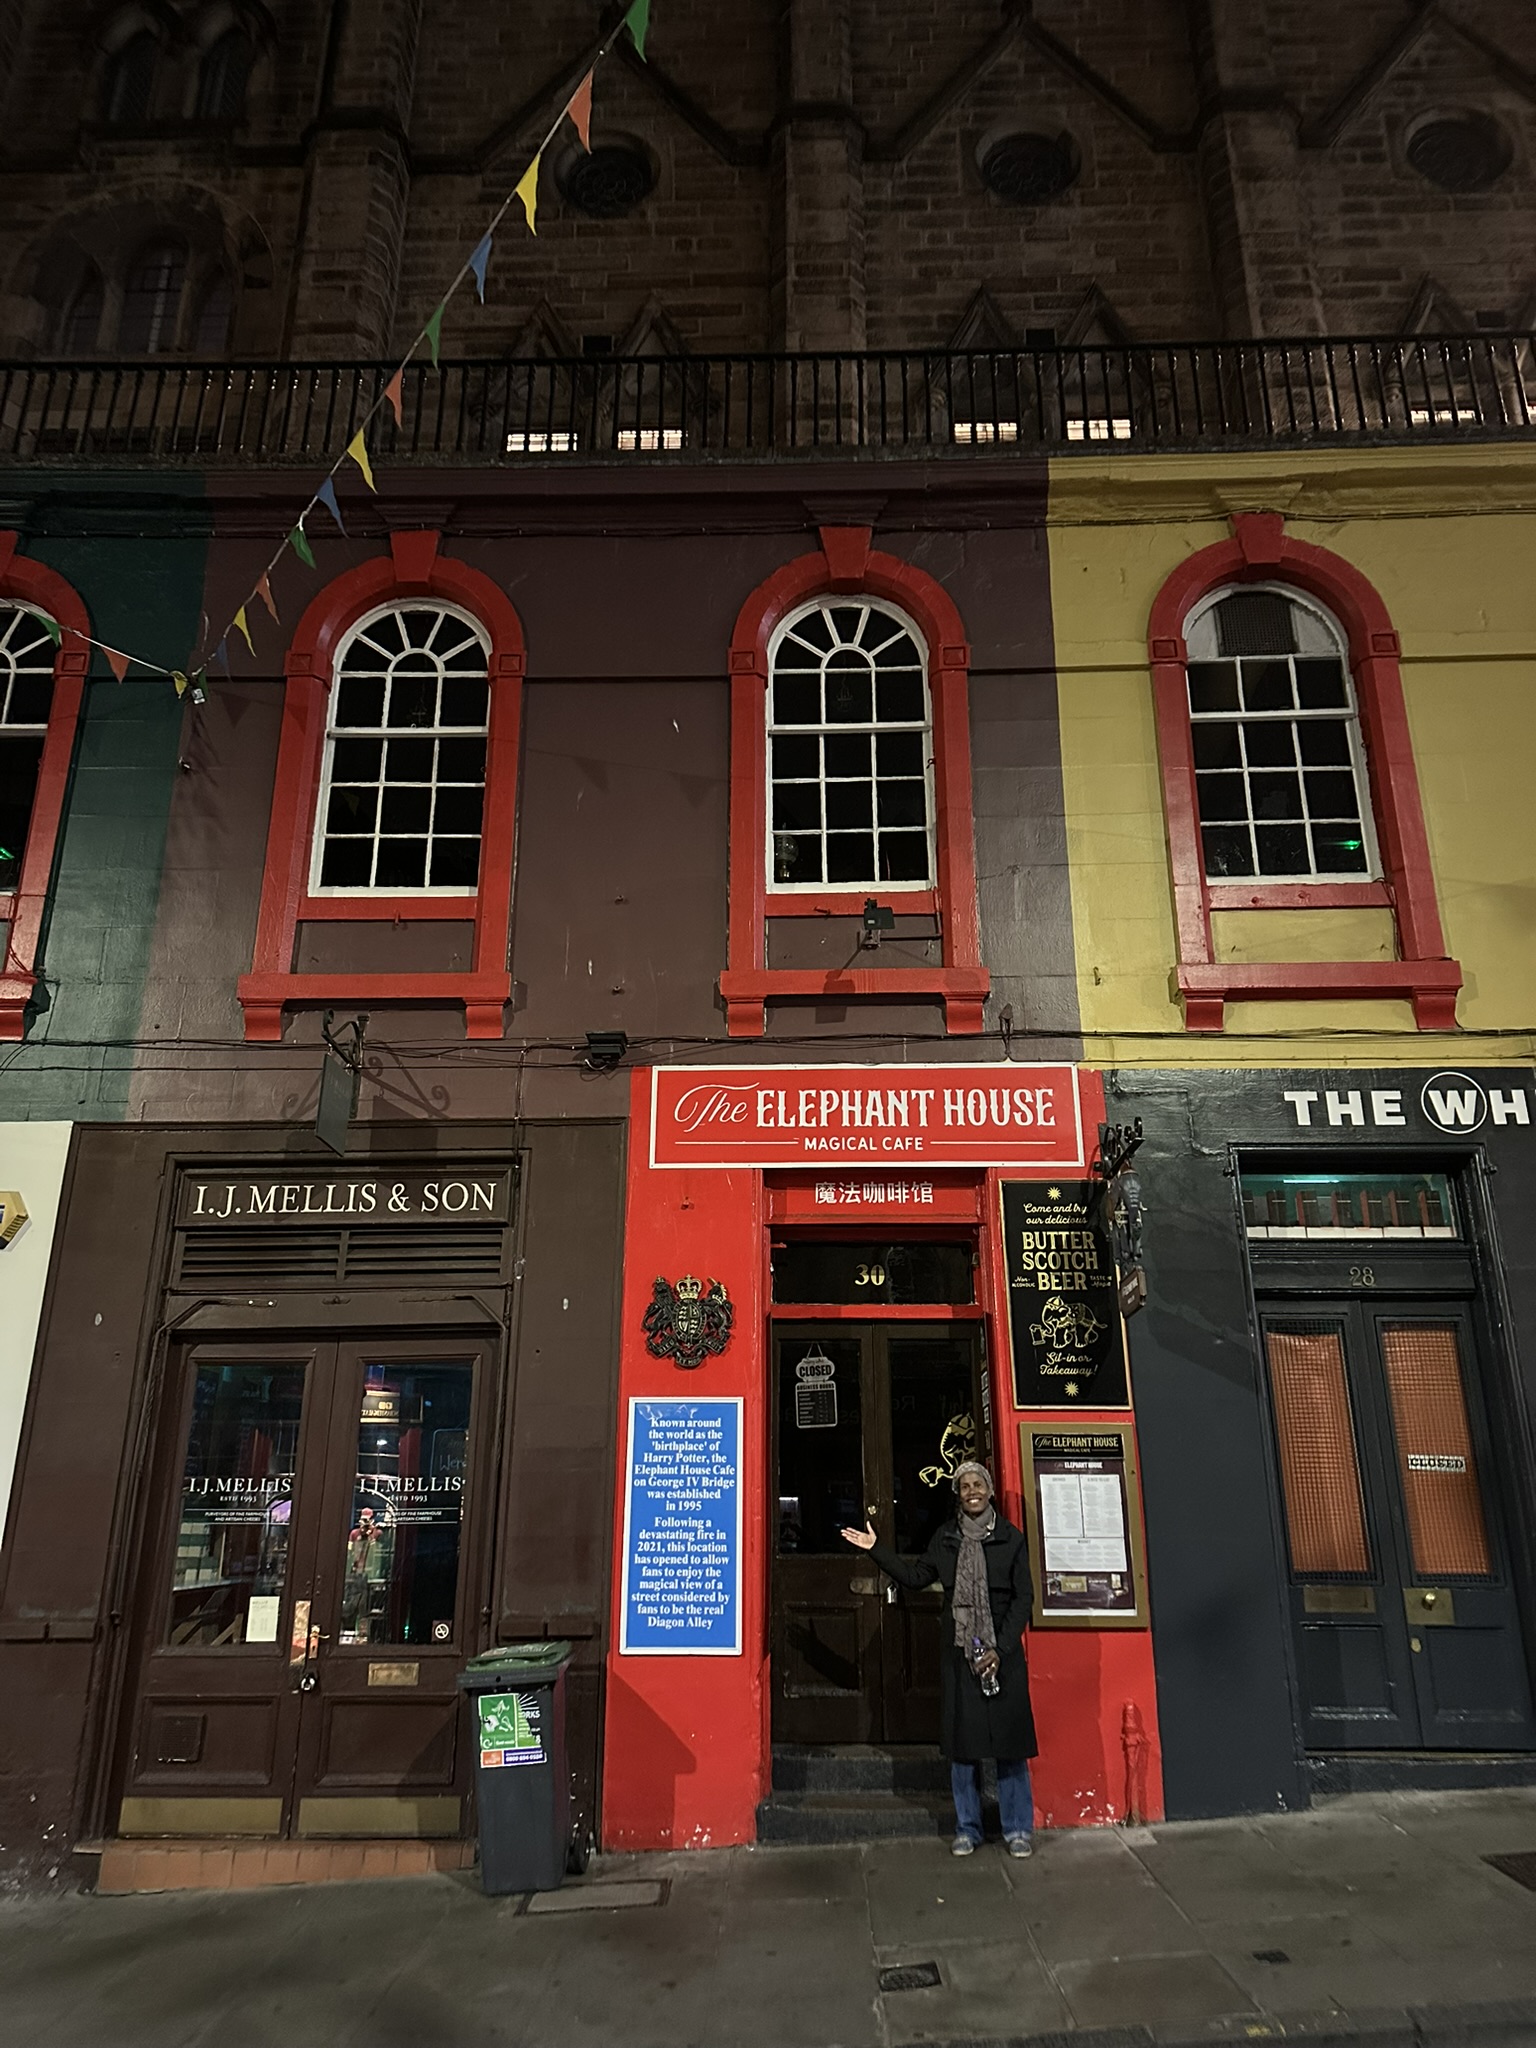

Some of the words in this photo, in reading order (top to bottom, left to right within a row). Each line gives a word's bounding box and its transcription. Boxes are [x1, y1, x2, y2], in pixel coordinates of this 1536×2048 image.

[674, 1082, 759, 1133] The
[756, 1090, 934, 1127] ELEPHANT
[943, 1089, 1056, 1127] HOUSE
[1283, 1090, 1406, 1126] THE
[1428, 1090, 1536, 1126] WH
[804, 1137, 877, 1151] MAGICAL
[881, 1137, 924, 1150] CAFE
[388, 1183, 410, 1212] &
[421, 1183, 497, 1212] SON
[814, 1182, 934, 1205] 魔法咖啡馆
[1023, 1203, 1051, 1213] Come
[1053, 1203, 1072, 1212] and
[1073, 1203, 1087, 1215] try
[1045, 1214, 1088, 1224] delicious
[1022, 1231, 1095, 1250] BUTTER
[1023, 1251, 1099, 1270] SCOTCH
[854, 1264, 885, 1285] 30
[1350, 1266, 1374, 1286] 28
[1037, 1272, 1088, 1290] BEER
[1046, 1351, 1077, 1363] Sit-in
[800, 1365, 831, 1377] CLOSED
[1040, 1365, 1098, 1377] Takeaway!
[651, 1417, 685, 1427] Known
[687, 1418, 721, 1427] around
[649, 1430, 664, 1439] the
[666, 1430, 694, 1439] world
[708, 1430, 723, 1439] the
[652, 1441, 707, 1453] 'birthplace'
[709, 1441, 720, 1451] of
[1035, 1436, 1052, 1448] The
[1053, 1437, 1092, 1448] ELEPHANT
[1093, 1437, 1119, 1447] HOUSE
[644, 1453, 673, 1465] Harry
[675, 1453, 710, 1464] Potter,
[712, 1453, 727, 1463] the
[1411, 1458, 1464, 1468] CLOSED
[635, 1465, 678, 1476] Elephant
[680, 1465, 711, 1474] House
[713, 1465, 735, 1475] Cafe
[648, 1477, 684, 1489] George
[687, 1477, 699, 1486] IV
[702, 1477, 735, 1489] Bridge
[667, 1489, 721, 1499] established
[666, 1501, 675, 1511] in
[678, 1501, 702, 1511] 1995
[655, 1517, 704, 1529] Following
[706, 1519, 712, 1527] a
[639, 1529, 695, 1541] devastating
[697, 1529, 715, 1539] fire
[716, 1530, 726, 1539] in
[638, 1541, 665, 1553] 2021,
[667, 1542, 685, 1552] this
[687, 1542, 727, 1552] location
[634, 1554, 651, 1564] has
[653, 1554, 688, 1566] opened
[690, 1556, 700, 1564] to
[702, 1554, 729, 1564] allow
[642, 1566, 662, 1576] fans
[664, 1568, 675, 1576] to
[676, 1566, 703, 1579] enjoy
[705, 1567, 721, 1577] the
[639, 1578, 678, 1591] magical
[680, 1579, 702, 1589] view
[704, 1579, 716, 1589] of
[631, 1592, 660, 1601] street
[661, 1591, 715, 1602] considered
[718, 1592, 730, 1605] by
[637, 1603, 658, 1614] fans
[660, 1605, 670, 1614] to
[672, 1604, 684, 1614] be
[686, 1604, 702, 1614] the
[704, 1604, 724, 1615] real
[648, 1616, 684, 1629] Diagon
[686, 1617, 713, 1630] Alley
